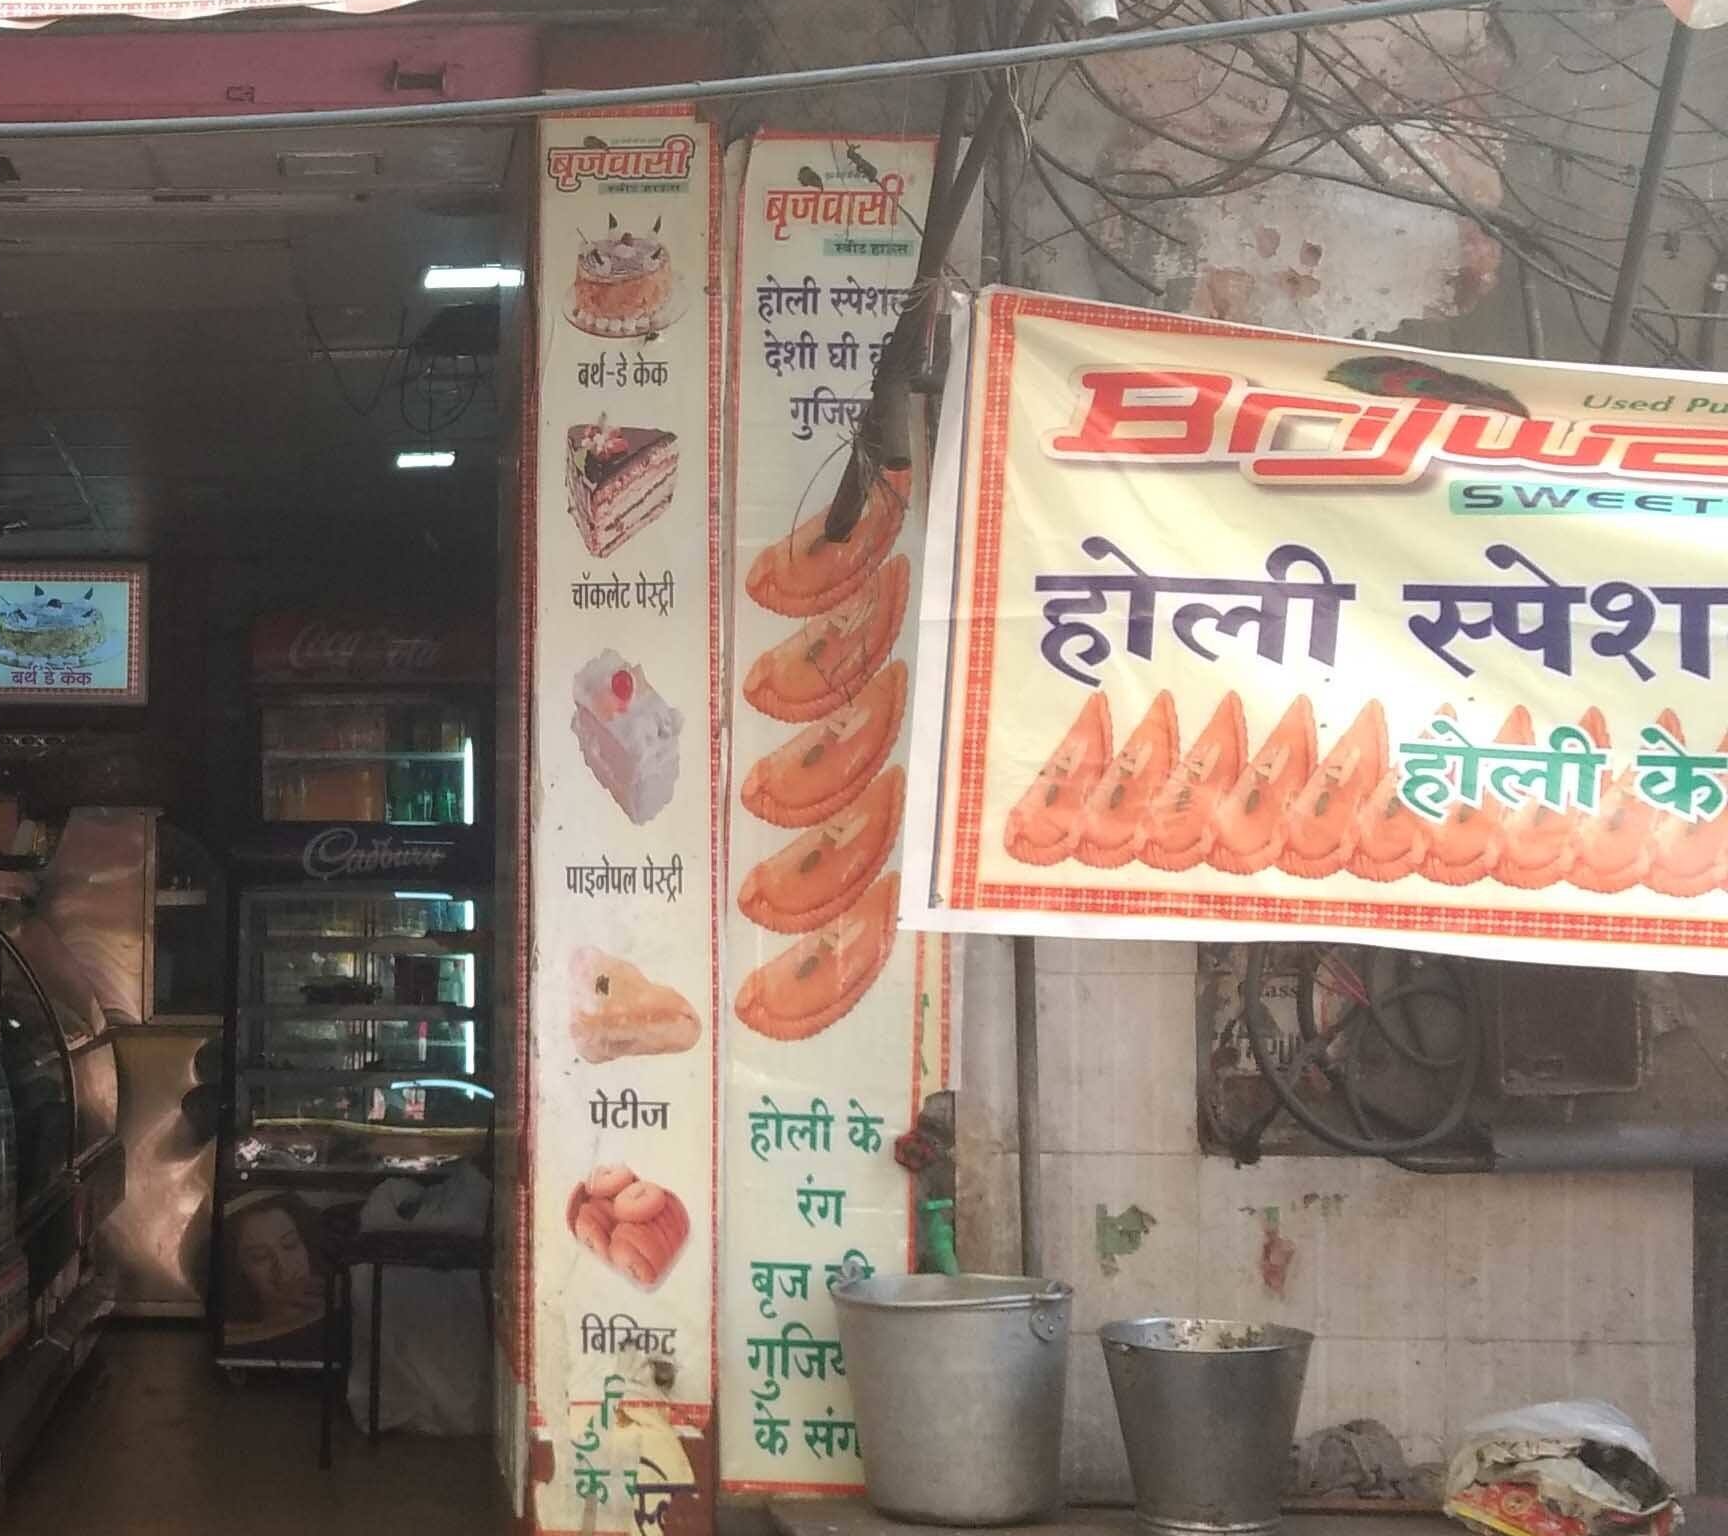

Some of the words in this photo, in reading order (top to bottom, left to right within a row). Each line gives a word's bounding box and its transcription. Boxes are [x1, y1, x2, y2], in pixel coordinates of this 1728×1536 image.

[756, 273, 822, 324] होली
[577, 352, 628, 388] बर्थ-डे
[633, 352, 669, 388] केक
[764, 328, 819, 378] देशी
[1050, 370, 1728, 478] Brijwa
[1582, 393, 1676, 413] Used
[1685, 397, 1728, 415] Pu
[1462, 482, 1724, 515] SWEET
[571, 571, 631, 611] चॉकलेट
[635, 570, 676, 617] पेस्ट्री
[1034, 535, 1357, 689] होली
[1402, 543, 1728, 683] स्पेश
[60, 666, 93, 685] केक
[1399, 720, 1608, 823] होली
[1636, 727, 1728, 822] के
[565, 855, 637, 897] पाइनेपल
[642, 854, 684, 903] पेस्ट्री
[588, 1088, 670, 1130] पेटीज
[748, 1095, 835, 1162] होली
[847, 1098, 885, 1154] के
[797, 1173, 847, 1228] रंग
[750, 1261, 813, 1320] बृज
[580, 1313, 677, 1355] बिस्किट
[752, 1400, 791, 1457] के
